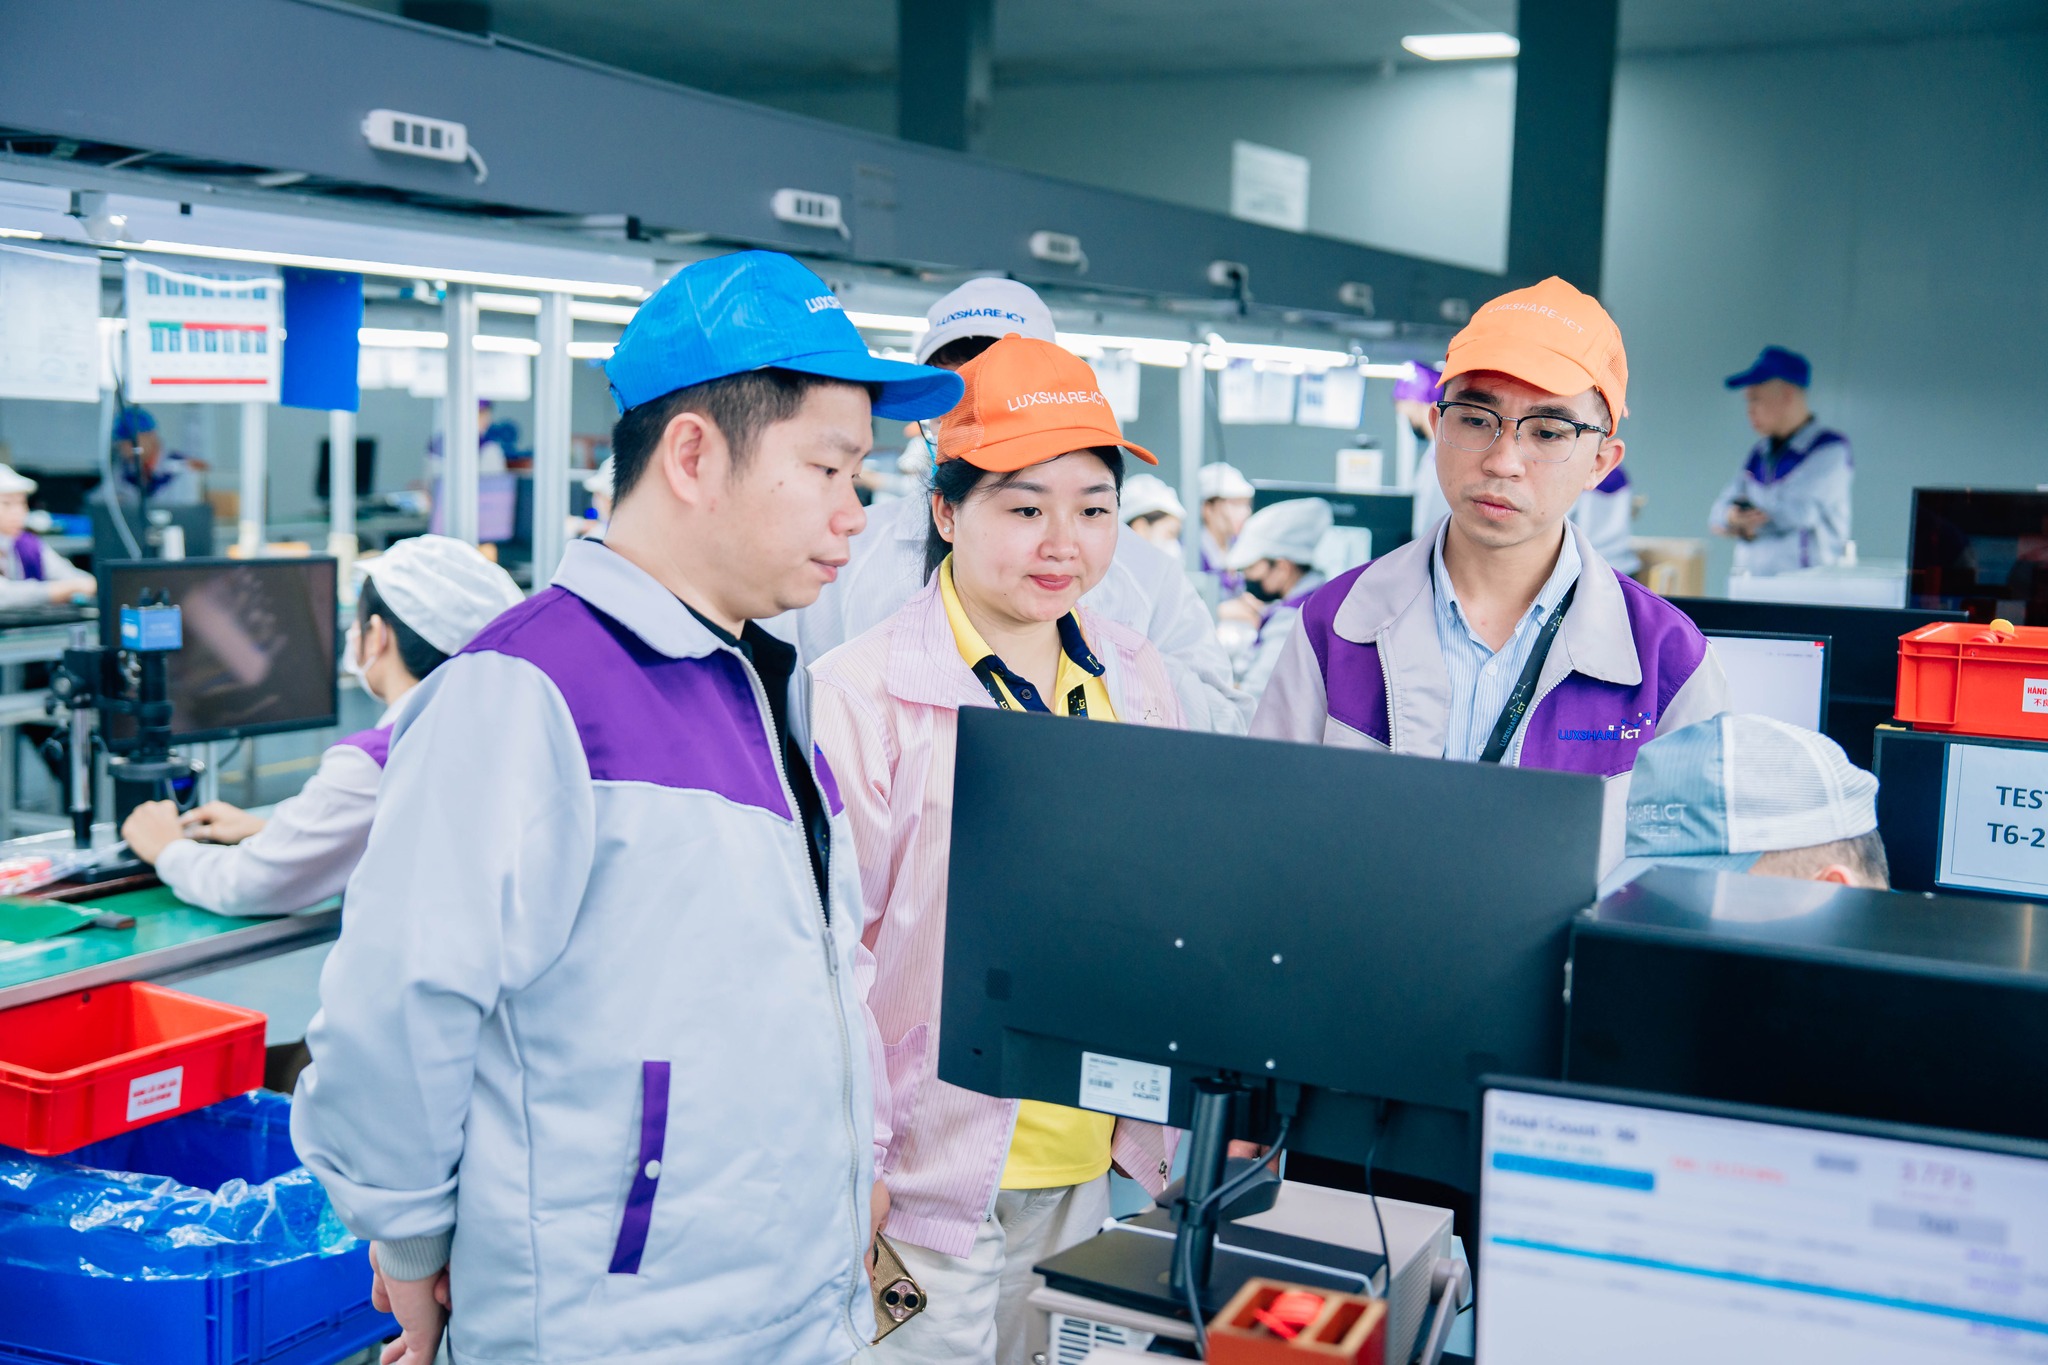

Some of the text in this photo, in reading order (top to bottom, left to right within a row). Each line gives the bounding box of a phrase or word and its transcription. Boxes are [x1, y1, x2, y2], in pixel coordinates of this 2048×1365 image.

[936, 307, 1026, 327] LUXSHARE-ICT
[1007, 390, 1105, 412] LUXSHARE-ICT
[1500, 701, 1526, 748] LUXSHARE ICT
[1557, 729, 1620, 741] LUXSHARE
[1995, 785, 2048, 810] TES
[1986, 821, 2047, 849] T6-2
